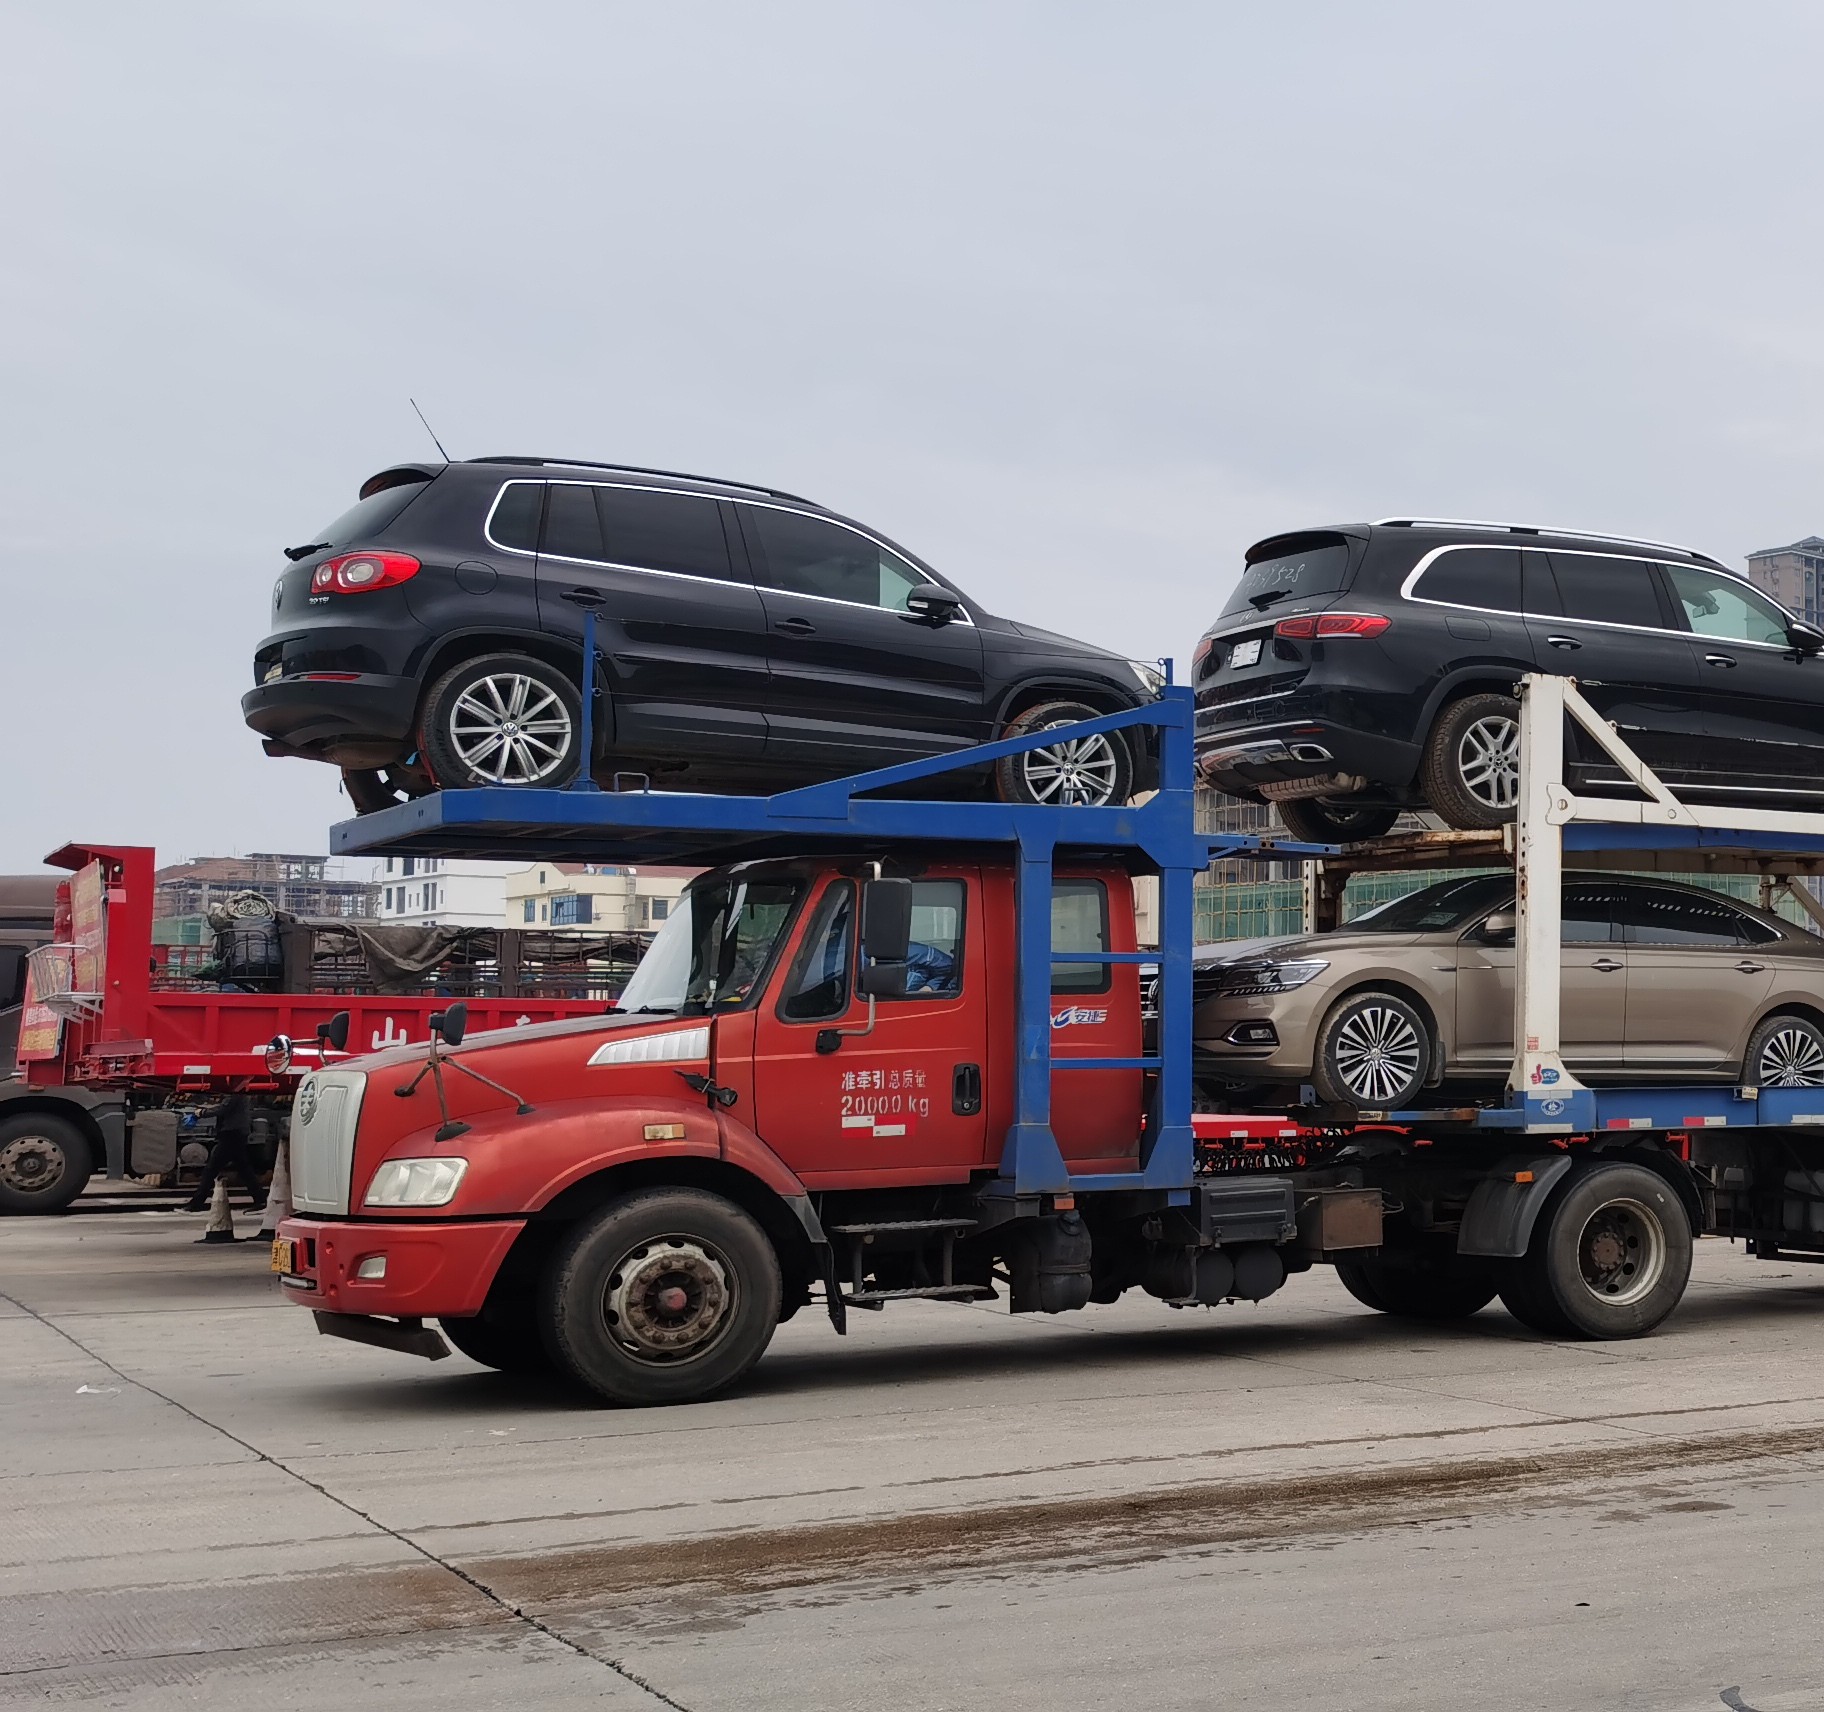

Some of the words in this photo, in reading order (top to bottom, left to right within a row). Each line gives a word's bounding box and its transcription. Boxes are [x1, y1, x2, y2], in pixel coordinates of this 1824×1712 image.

[841, 1069, 927, 1091] 准牵引总质量
[841, 1094, 902, 1116] 20000
[908, 1094, 929, 1118] kg
